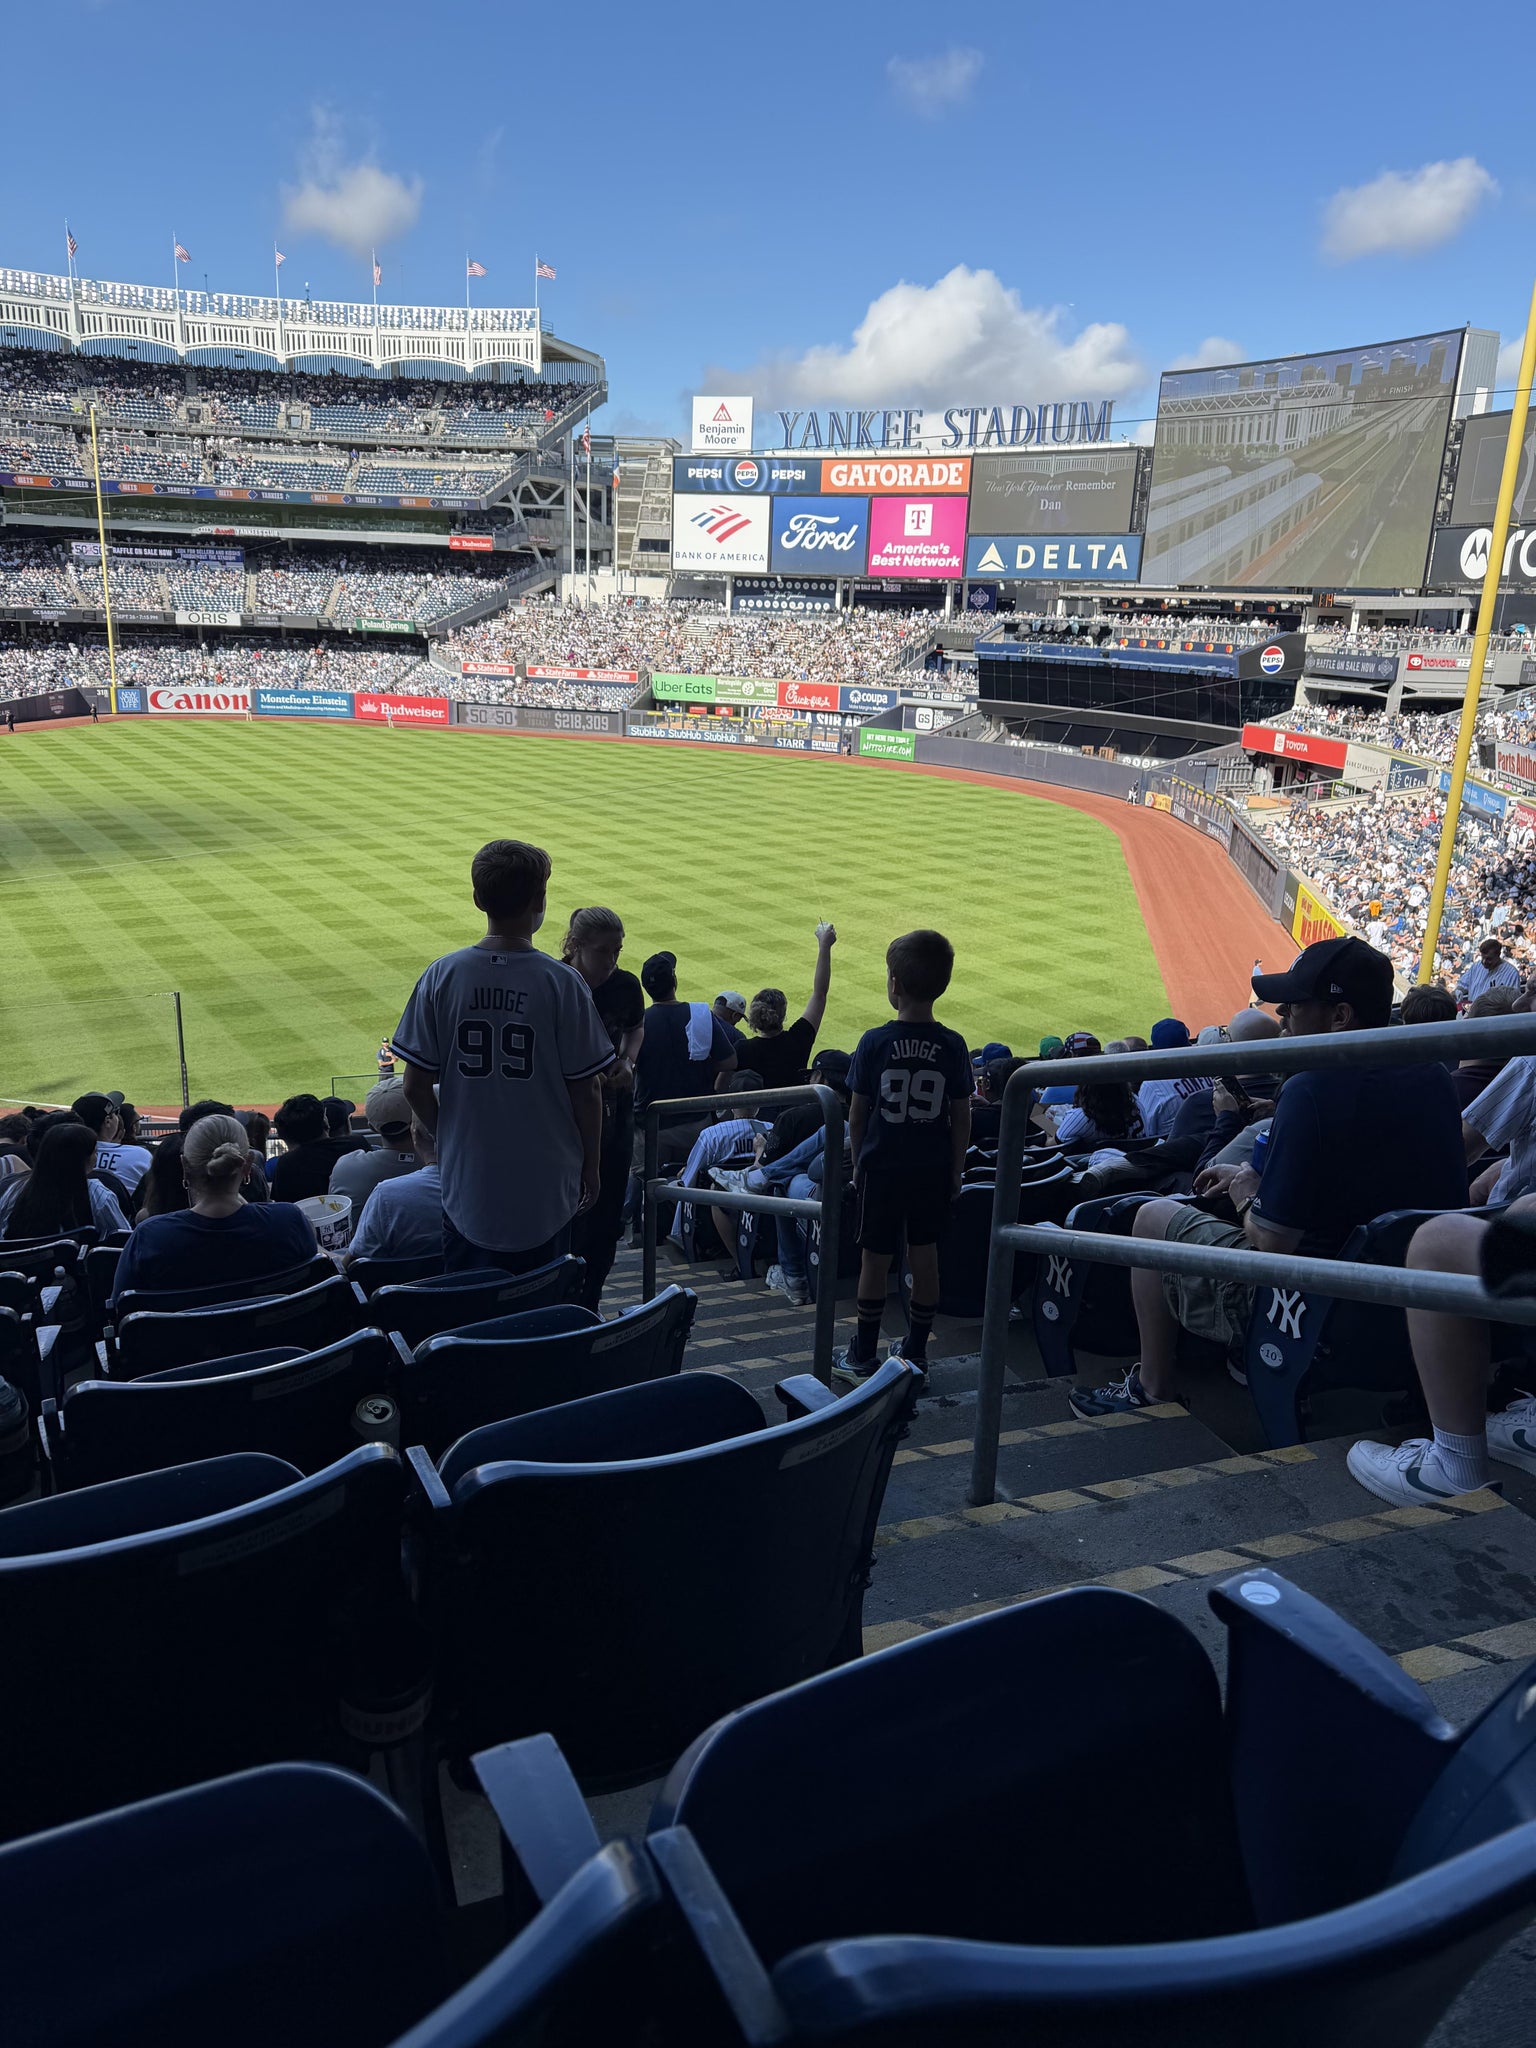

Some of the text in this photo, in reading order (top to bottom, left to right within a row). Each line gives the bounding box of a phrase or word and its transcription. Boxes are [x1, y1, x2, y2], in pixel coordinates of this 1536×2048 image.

[1388, 384, 1414, 394] FINISH
[700, 423, 745, 436] Benjamin
[775, 400, 1116, 450] YANKEE STADIUM
[704, 434, 737, 445] Moore
[688, 468, 722, 479] PEPSI
[736, 470, 757, 478] PEPSI
[772, 469, 806, 480] PEPSI
[830, 463, 963, 486] GATORADE
[986, 480, 1116, 498] New York Yankees Remember
[1040, 499, 1061, 511] Dan
[911, 510, 926, 530] T
[781, 513, 859, 551] Ford
[462, 540, 490, 548] Budweiser
[882, 542, 950, 555] America's
[144, 548, 158, 556] SALE
[675, 551, 765, 562] BANK OF AMERICA
[1016, 544, 1128, 570] DELTA
[872, 554, 960, 568] Best Network
[188, 612, 228, 624] ORIS
[362, 620, 410, 632] Poland Spring
[1262, 656, 1283, 664] PEPSI
[1316, 659, 1376, 672] RAFFLE ON SALE NOW
[1423, 658, 1494, 668] TOYOTA TERCE
[656, 681, 682, 692] Uber
[686, 683, 712, 694] Eats
[150, 690, 248, 710] Canon
[260, 694, 346, 706] Montefiore Einstein
[862, 692, 888, 705] coupa
[381, 702, 445, 718] Budweiser
[470, 709, 513, 725] 50 50
[554, 712, 608, 730] $218,309
[918, 714, 930, 723] GS
[631, 727, 666, 737] StubHub
[668, 730, 702, 740] StubHub
[704, 732, 736, 743] StubHub
[777, 738, 804, 748] STARR
[1286, 740, 1308, 752] TOYOTA
[1498, 752, 1516, 774] Parts
[469, 987, 528, 1014] JUDGE
[457, 1018, 536, 1080] 99
[892, 1040, 942, 1062] JUDGE
[881, 1069, 946, 1123] 99
[96, 1152, 122, 1171] GE
[742, 1210, 753, 1232] NY
[1046, 1254, 1073, 1298] NY
[1266, 1286, 1306, 1339] NY
[1264, 1349, 1276, 1362] 10
